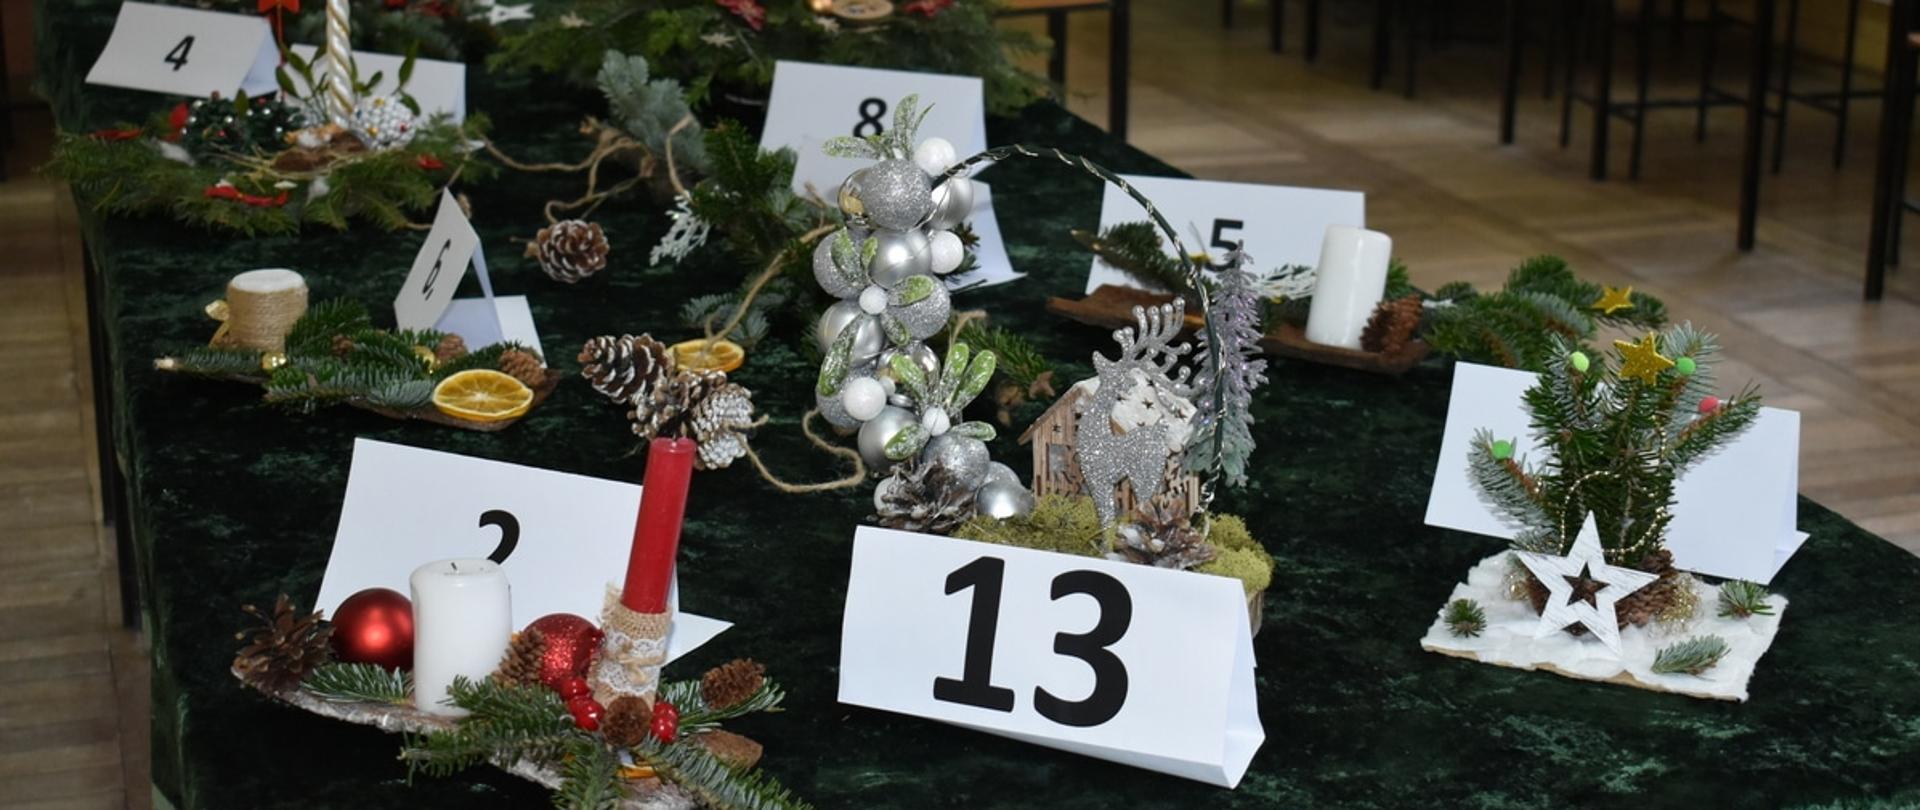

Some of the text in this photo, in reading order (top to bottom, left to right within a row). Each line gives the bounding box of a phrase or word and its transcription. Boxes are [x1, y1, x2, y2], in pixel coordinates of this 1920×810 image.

[164, 35, 195, 71] 4
[853, 97, 887, 140] 8
[1203, 218, 1244, 273] 5
[933, 556, 1132, 727] 13
